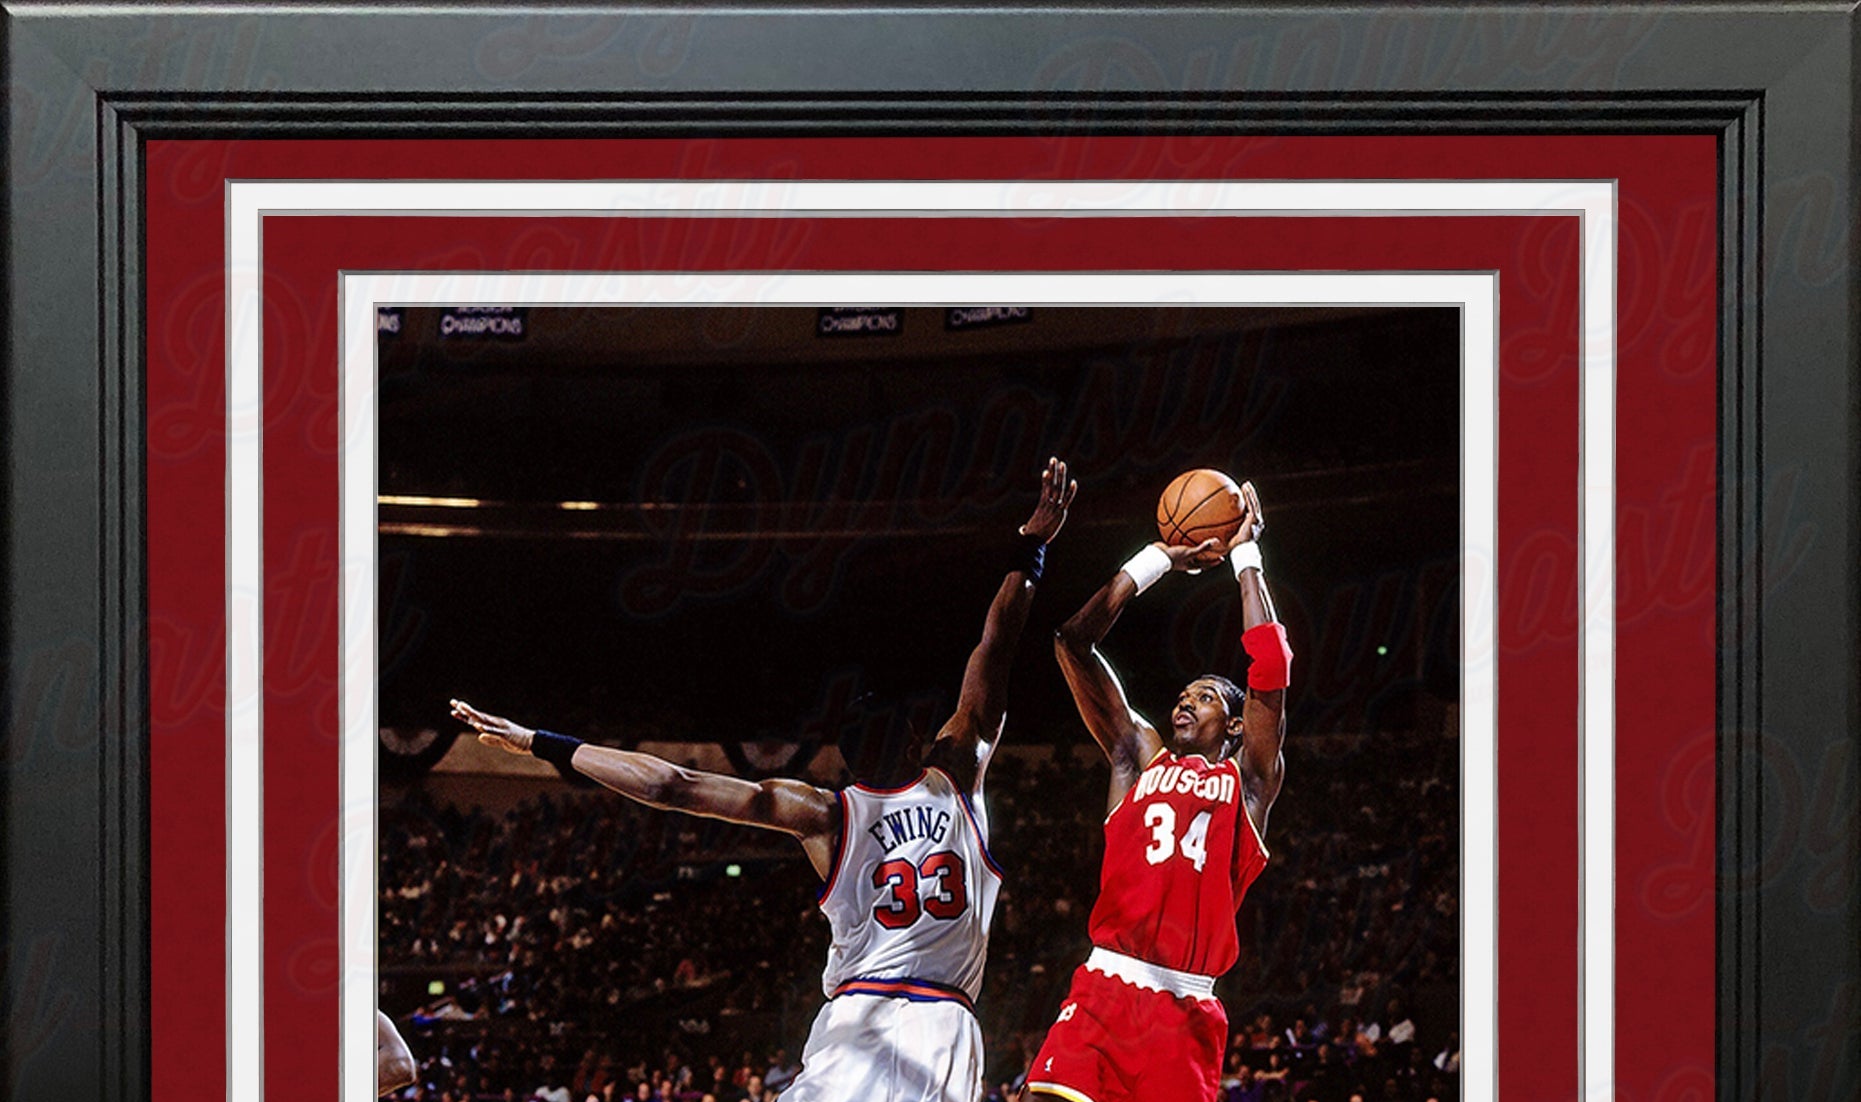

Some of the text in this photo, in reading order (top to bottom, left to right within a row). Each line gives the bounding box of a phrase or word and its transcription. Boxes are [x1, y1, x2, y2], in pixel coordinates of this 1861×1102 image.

[868, 806, 950, 855] EWING
[1144, 802, 1212, 873] 34
[872, 849, 969, 930] 33
